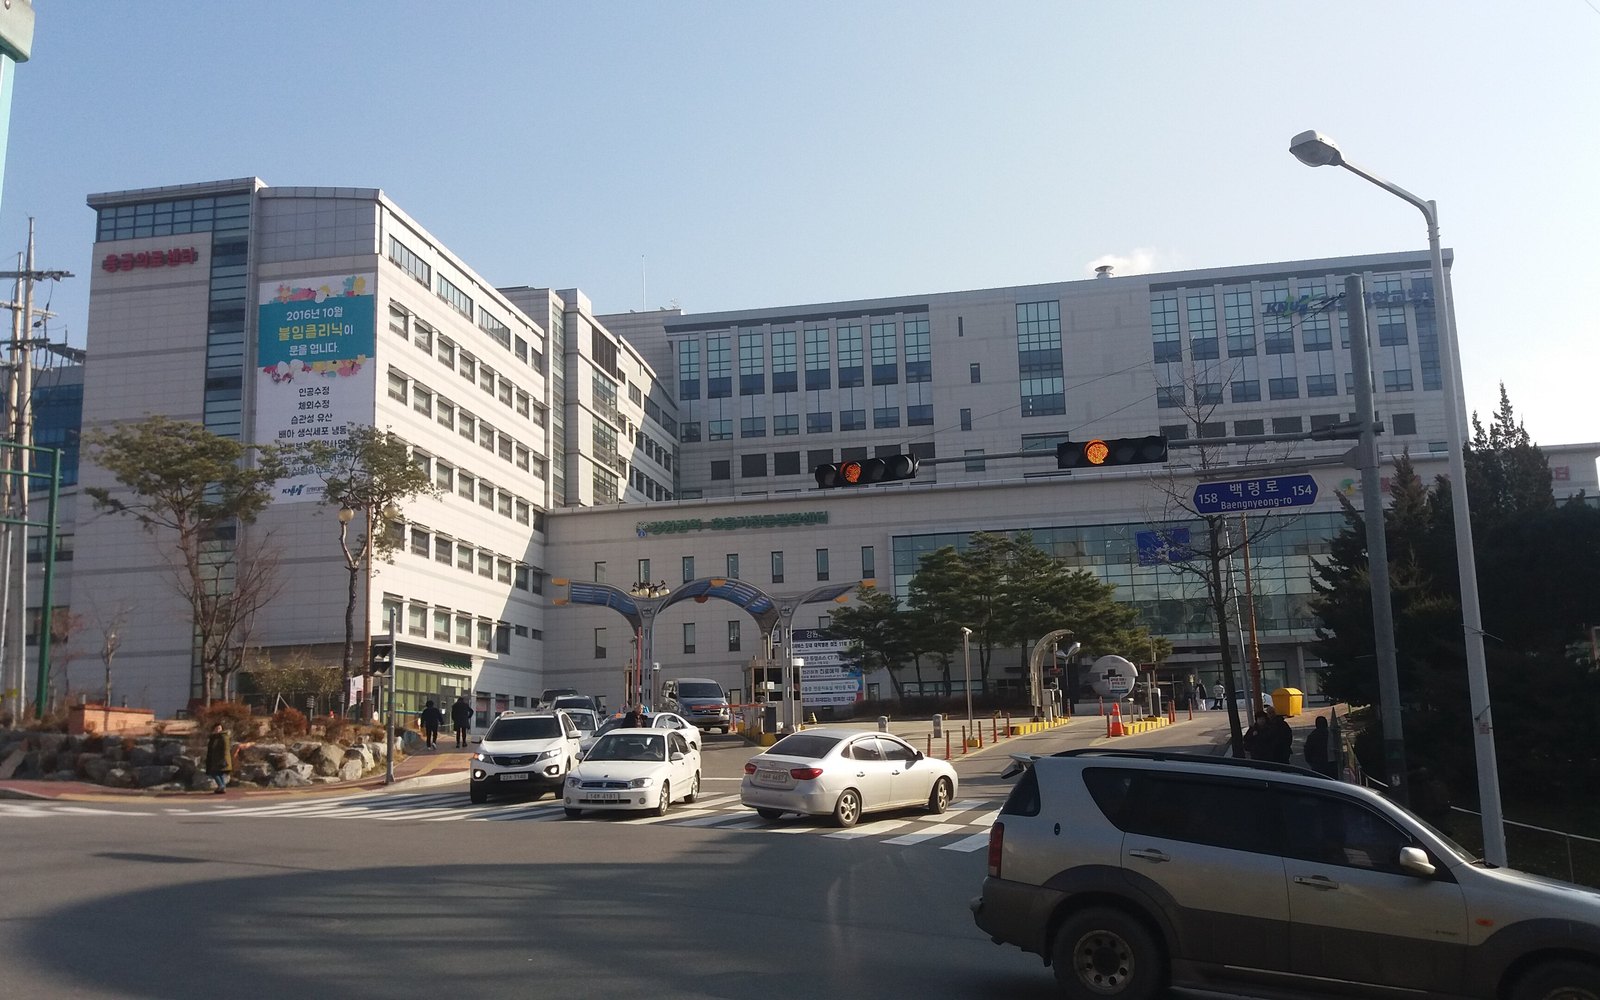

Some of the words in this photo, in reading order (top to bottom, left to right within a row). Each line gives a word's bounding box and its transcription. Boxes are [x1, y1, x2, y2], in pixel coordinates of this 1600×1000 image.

[286, 308, 320, 321] 2016년
[322, 306, 343, 318] 10월
[279, 322, 353, 341] 불임클리닉이
[289, 344, 307, 356] 문을
[310, 342, 340, 355] 엽니다.
[299, 386, 330, 397] 인공수정
[298, 400, 330, 410] 체외수정
[291, 414, 314, 425] 습관성
[317, 413, 333, 422] 유산
[279, 429, 294, 439] 배아
[297, 427, 329, 438] 생식세포
[332, 425, 347, 436] 냉동
[1230, 480, 1279, 497] 백령로
[1292, 484, 1312, 496] 154
[1199, 493, 1218, 504] 158
[1221, 497, 1292, 510] Baengnyeong-ro
